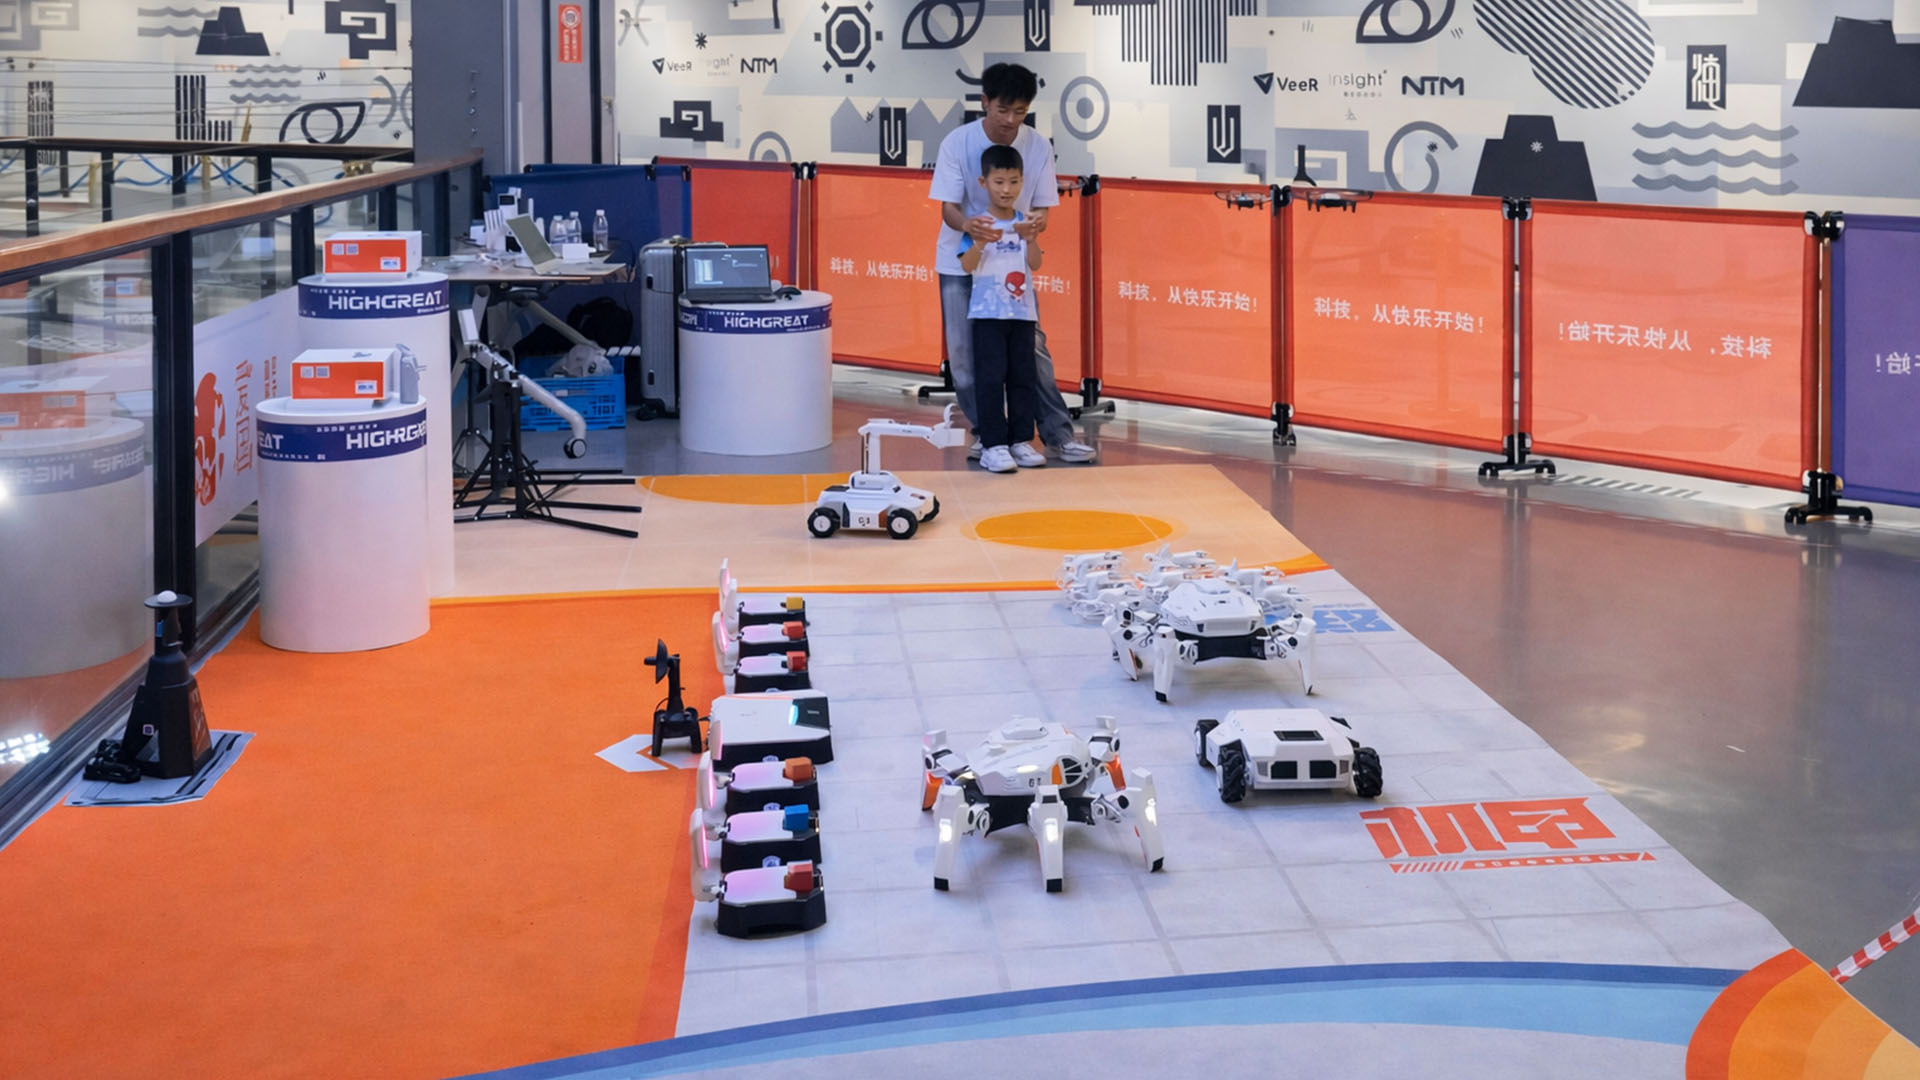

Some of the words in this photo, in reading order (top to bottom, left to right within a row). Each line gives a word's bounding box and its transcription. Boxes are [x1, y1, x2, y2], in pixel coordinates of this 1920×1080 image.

[667, 61, 693, 72] VeeR
[740, 57, 778, 74] NTM
[1276, 76, 1319, 92] VeeR
[1401, 75, 1465, 96] NTM
[328, 290, 442, 310] HIGHGREAT
[724, 315, 809, 329] HIGHGREAT
